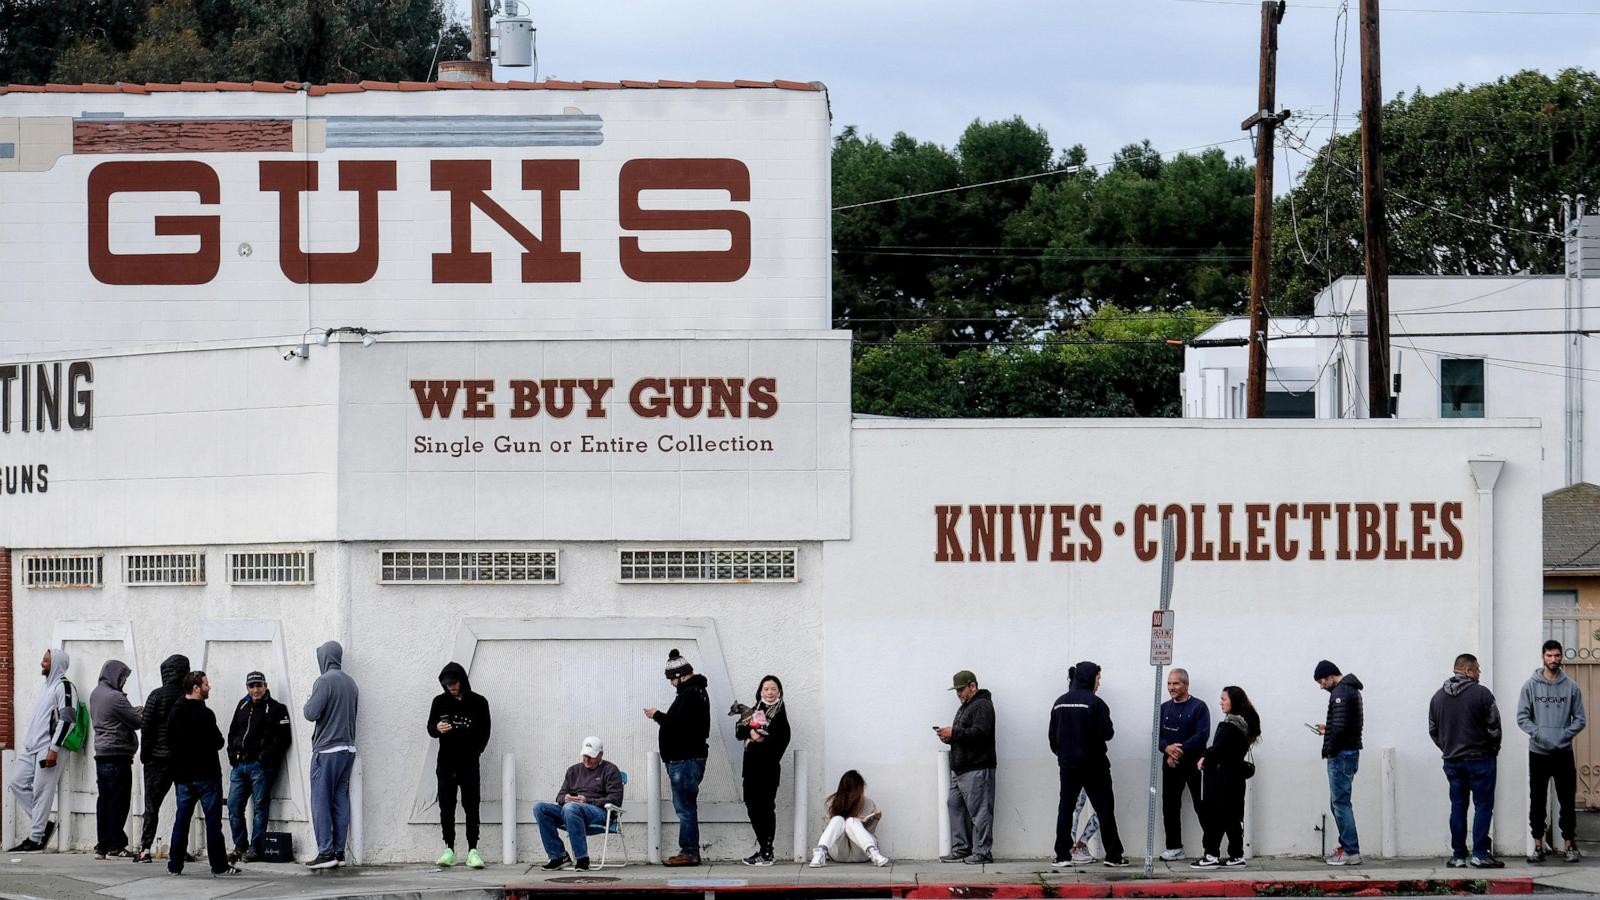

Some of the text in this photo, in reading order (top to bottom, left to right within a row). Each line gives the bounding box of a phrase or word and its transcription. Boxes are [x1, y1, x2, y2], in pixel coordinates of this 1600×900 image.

[88, 158, 751, 285] GUNS
[0, 359, 95, 434] TING
[409, 377, 779, 420] WE BUY GUNS
[414, 434, 774, 458] Single Gun or Entire Collection
[0, 464, 49, 496] UNS
[934, 503, 1103, 563] KNIVES
[1153, 613, 1162, 626] NO
[1535, 696, 1568, 704] ROGUE
